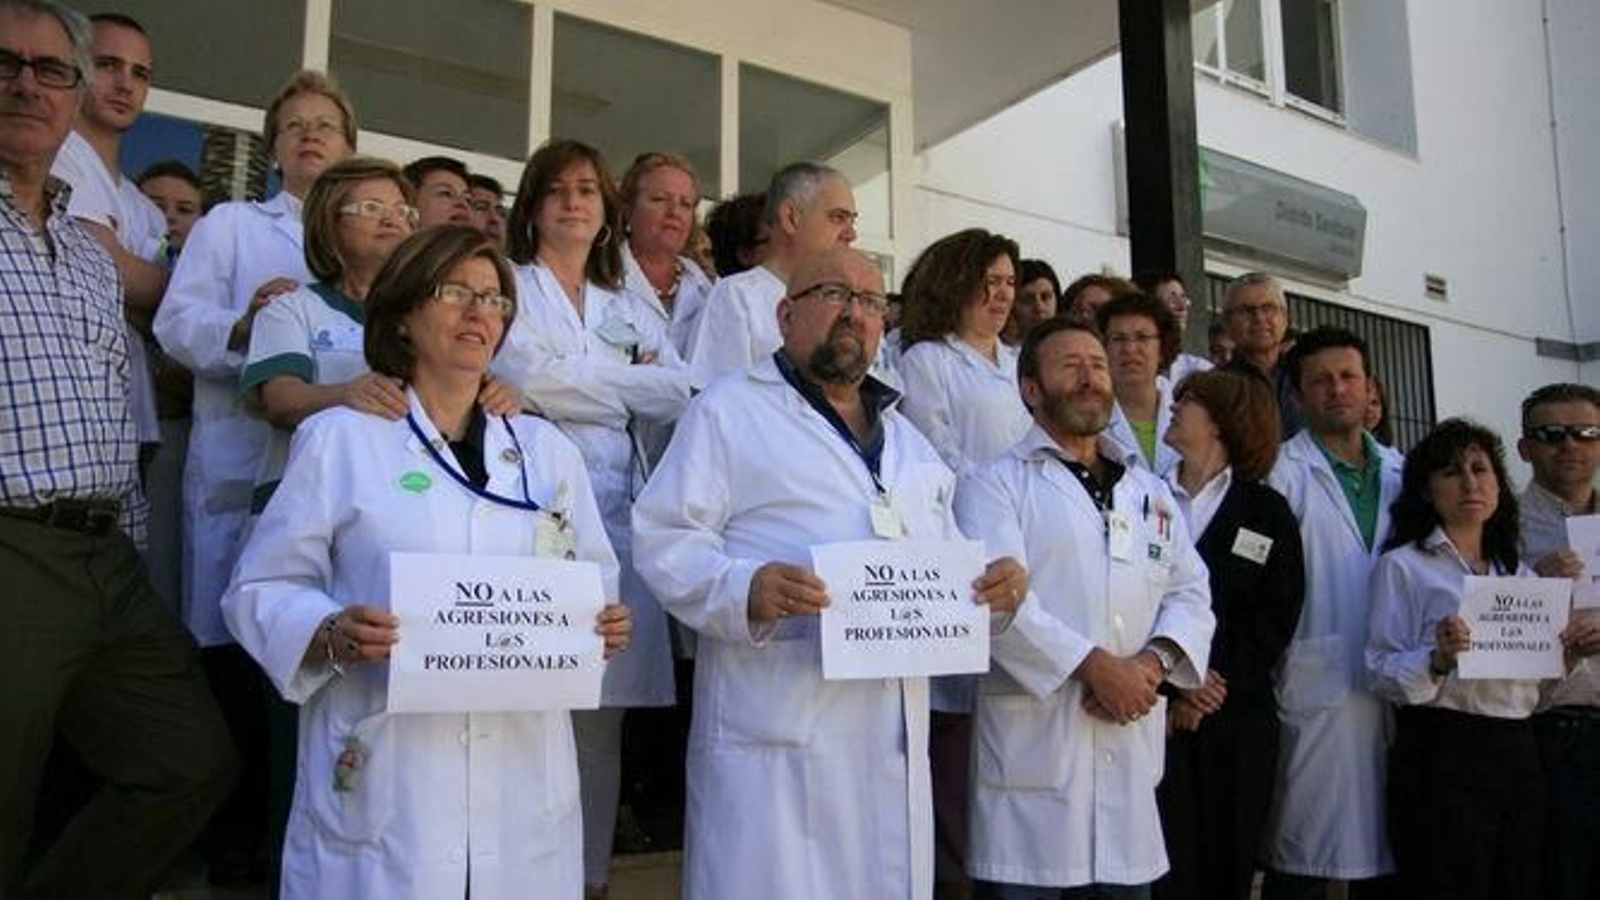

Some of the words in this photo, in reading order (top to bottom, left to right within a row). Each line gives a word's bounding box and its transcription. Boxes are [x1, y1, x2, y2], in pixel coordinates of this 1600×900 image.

[865, 565, 895, 582] NO
[900, 571, 910, 582] A
[912, 569, 940, 582] LAS
[455, 582, 494, 603] NO
[499, 590, 511, 602] A
[517, 588, 552, 603] LAS
[851, 588, 945, 602] AGRESIONES
[949, 590, 958, 601] A
[434, 610, 553, 626] AGRESIONES
[558, 613, 569, 627] A
[891, 608, 923, 621] L@S
[485, 632, 525, 648] L@S
[845, 625, 970, 641] PROFESIONALES
[424, 654, 578, 670] PROFESIONALES
